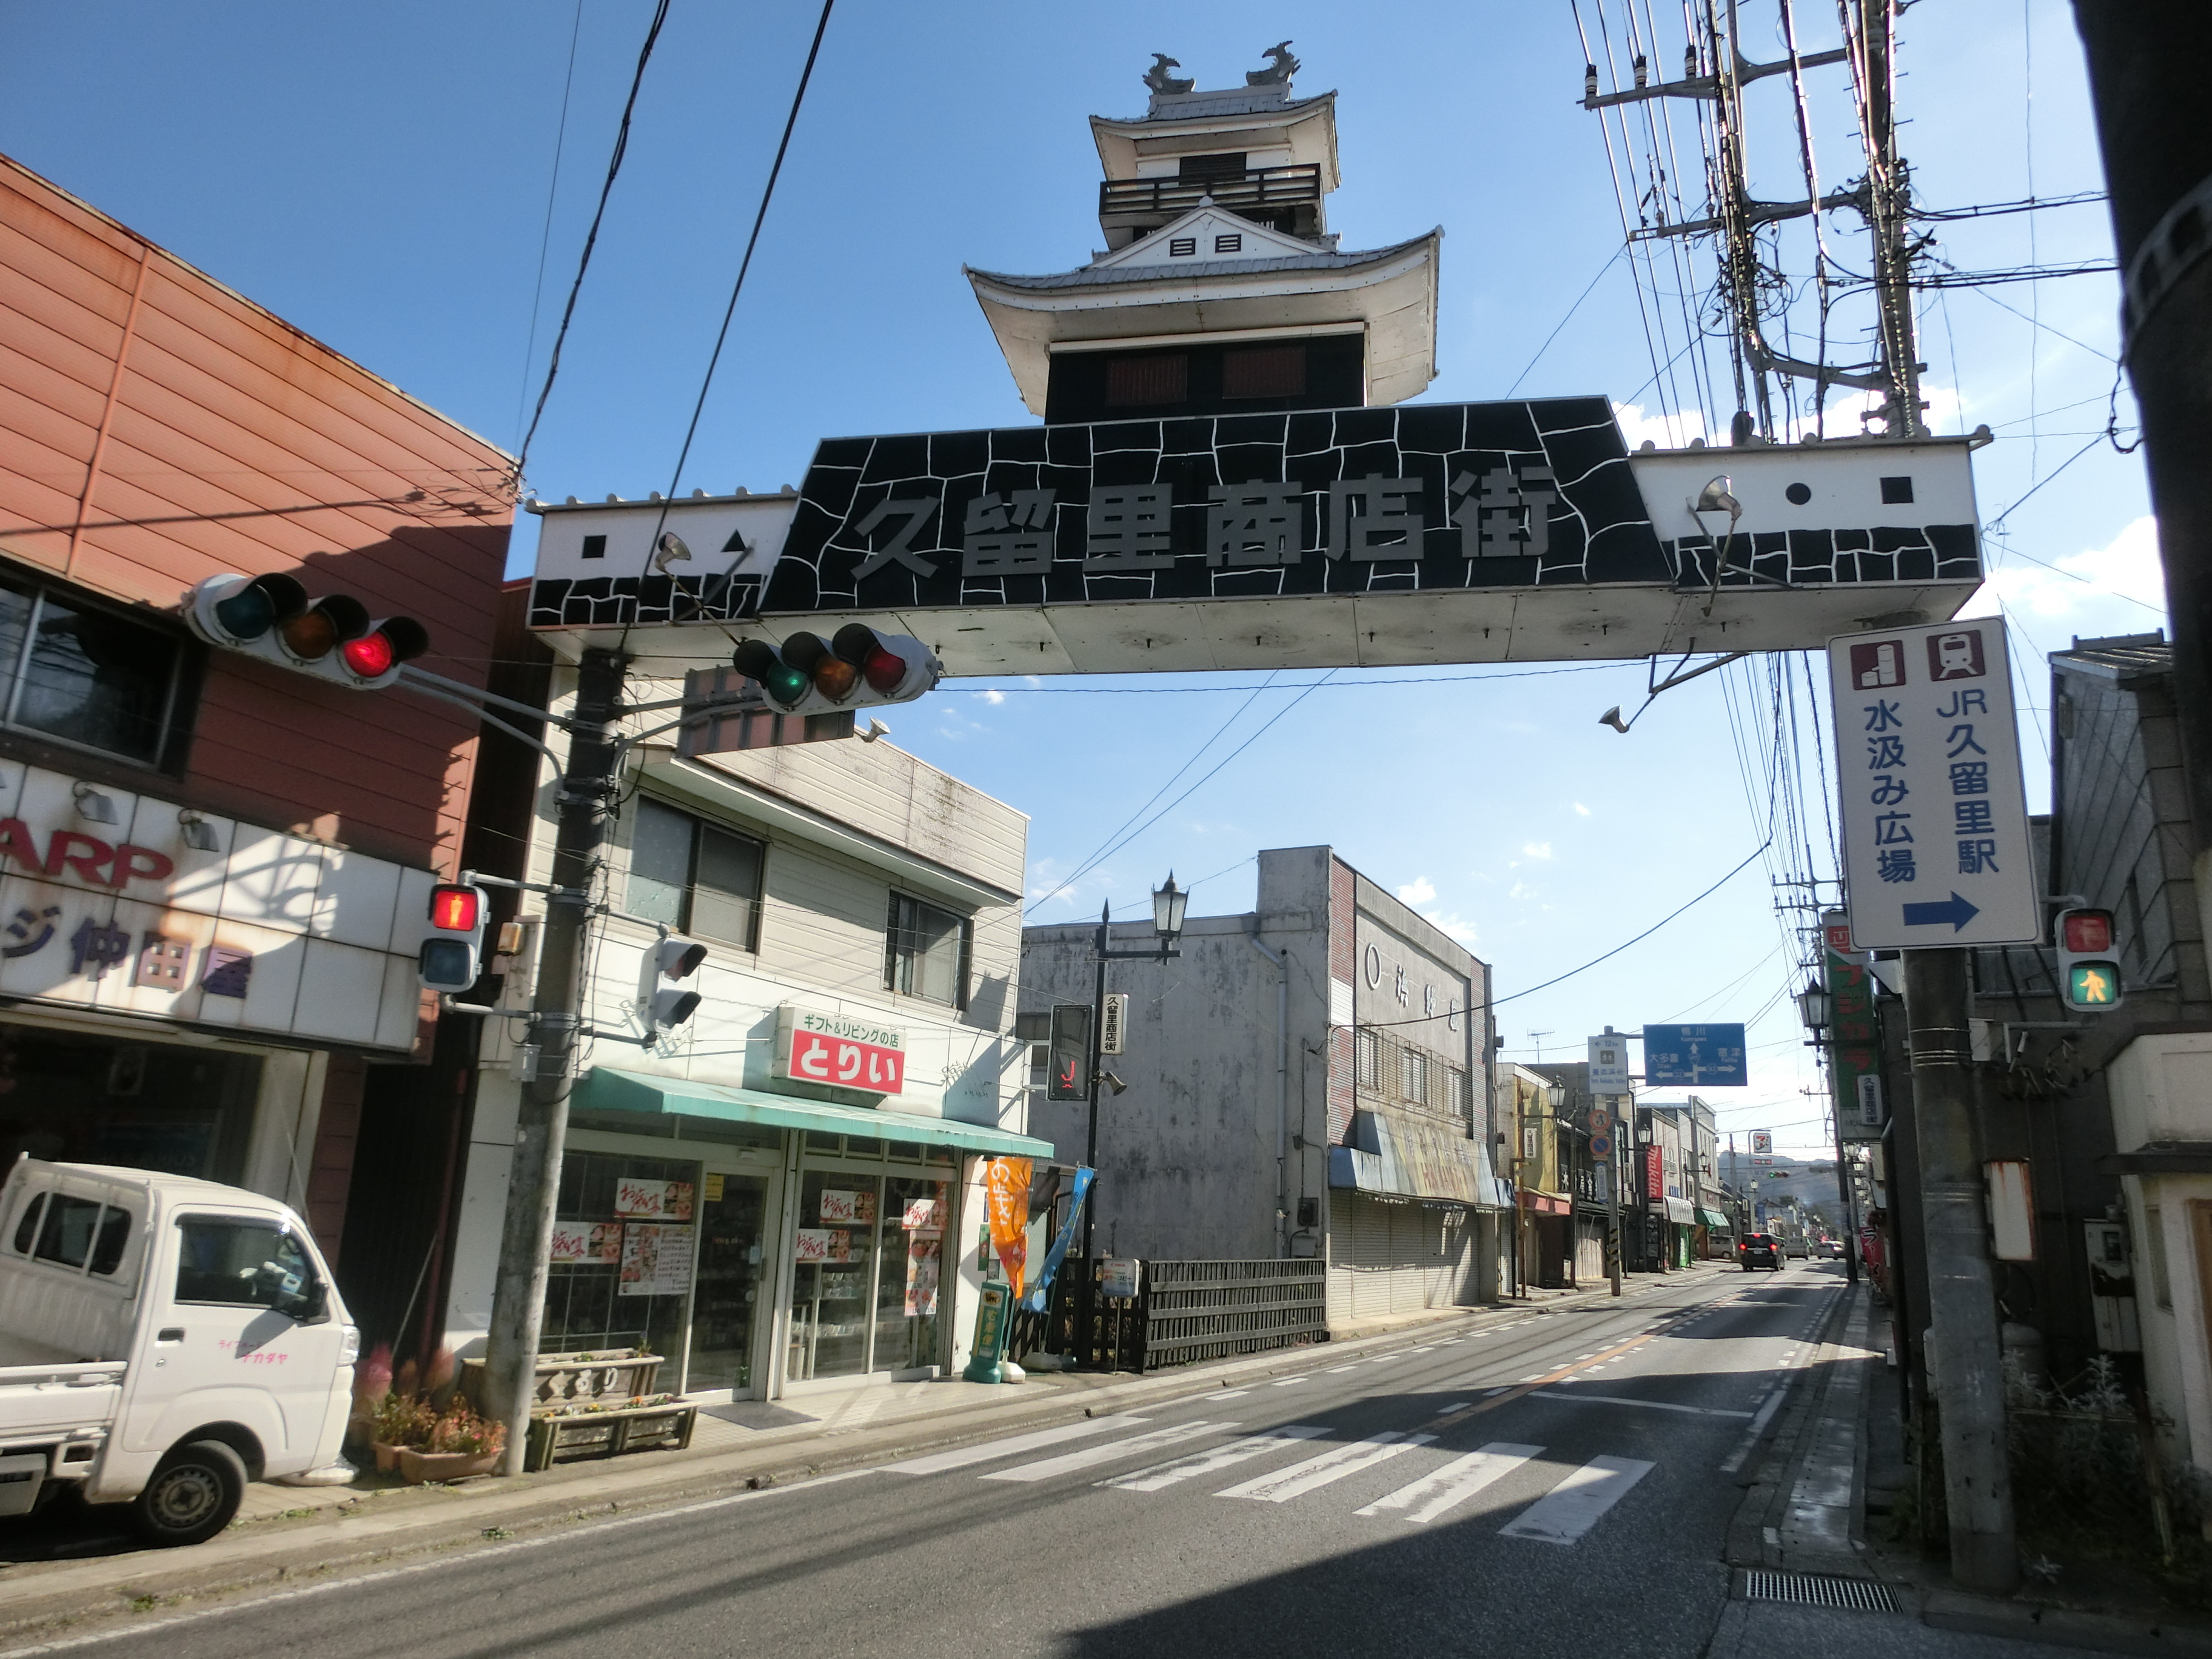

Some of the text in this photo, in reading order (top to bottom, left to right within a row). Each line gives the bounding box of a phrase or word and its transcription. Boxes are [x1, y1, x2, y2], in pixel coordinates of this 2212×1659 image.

[851, 467, 1557, 580] 久留里商店街
[1864, 699, 1915, 883] 水汲み広場
[1937, 689, 1999, 874] JR久留里駅
[804, 1013, 899, 1048] ギフト&リビングの店
[1105, 996, 1119, 1051] 久留里商店街
[800, 1037, 896, 1084] とりい
[1649, 1053, 1678, 1062] 大多喜
[1647, 1146, 1660, 1198] makita
